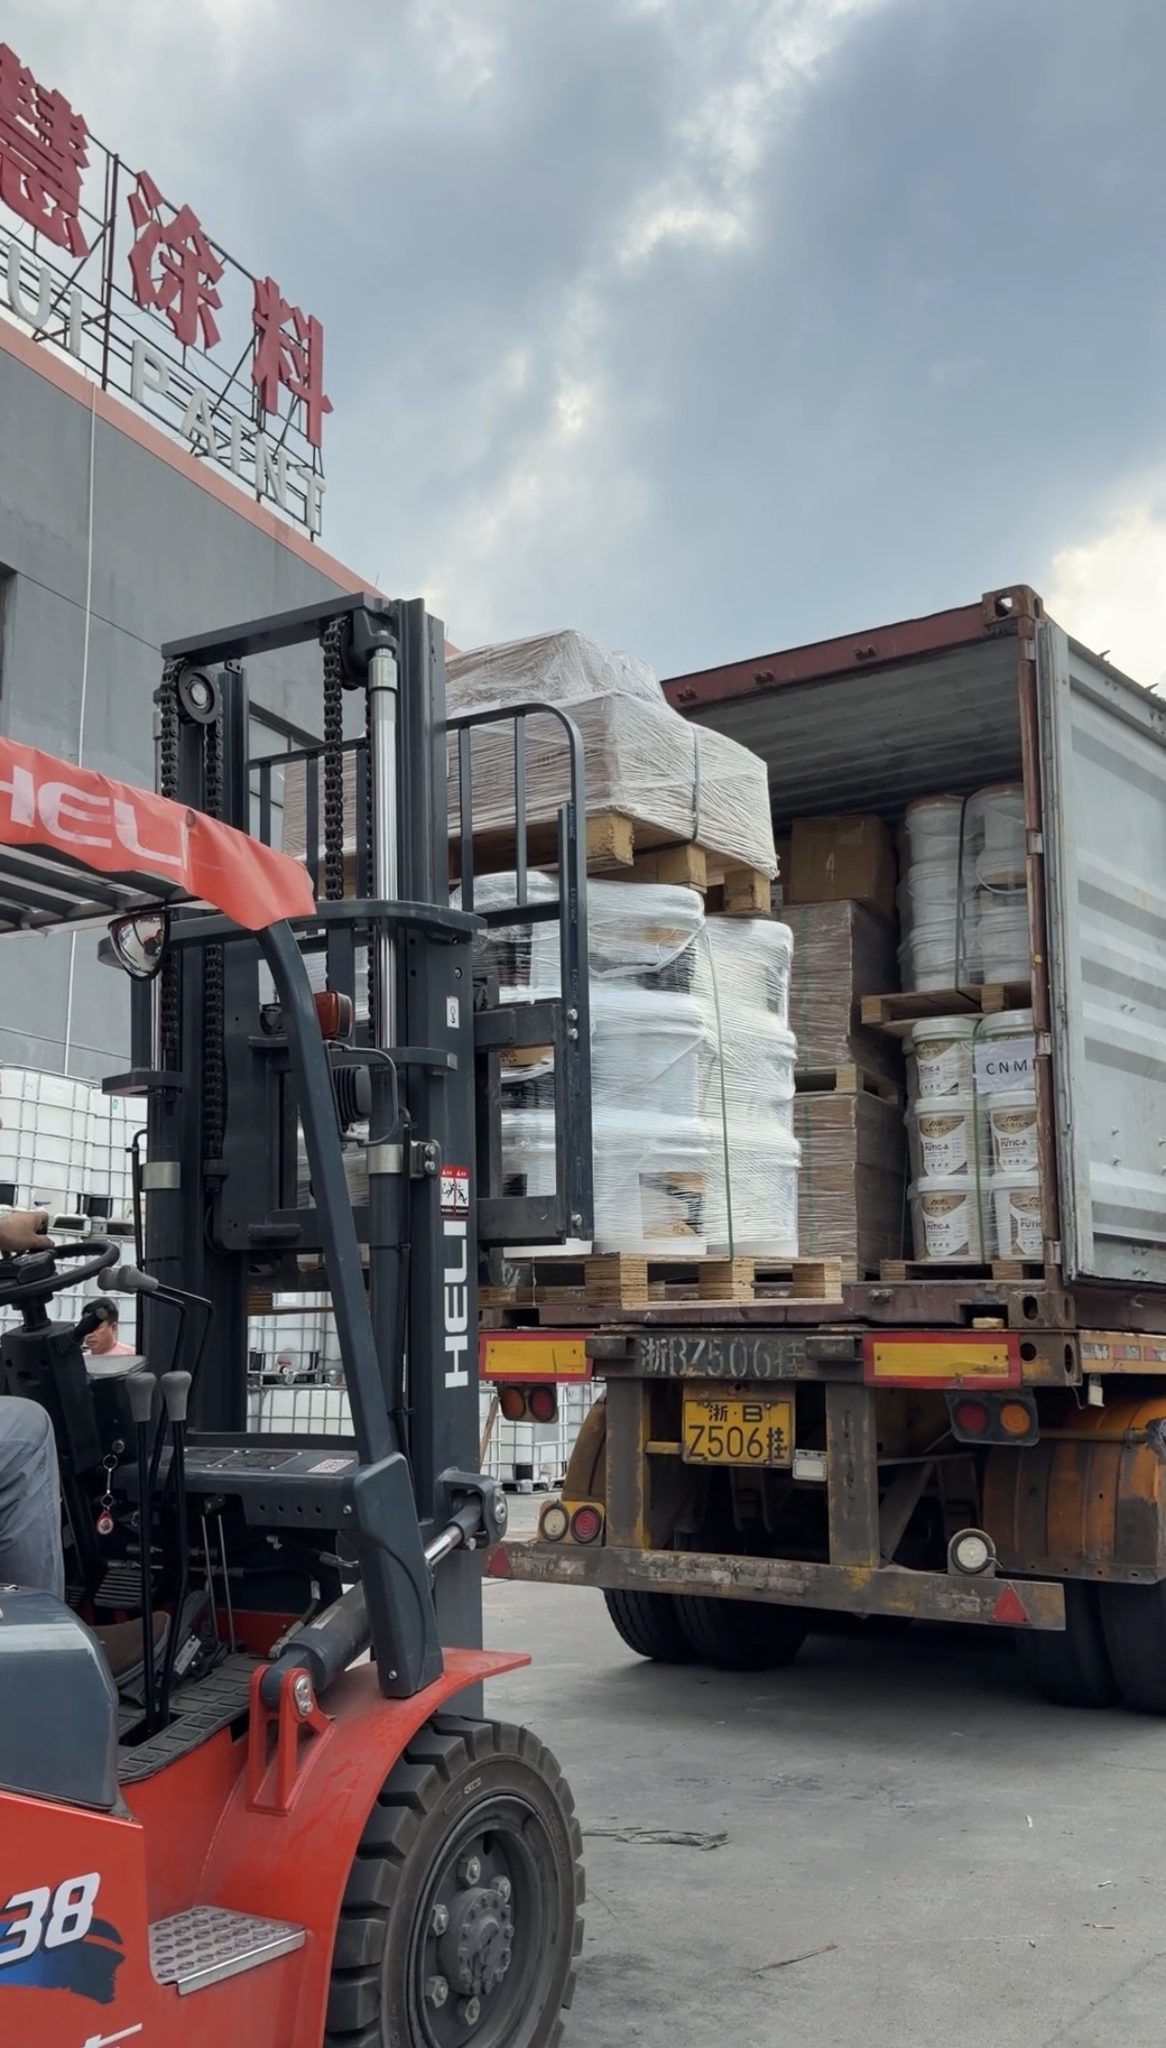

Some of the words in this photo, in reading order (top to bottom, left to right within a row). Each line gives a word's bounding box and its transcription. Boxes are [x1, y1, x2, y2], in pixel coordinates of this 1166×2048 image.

[131, 338, 326, 531] PAINT
[443, 1220, 469, 1388] HELI
[0, 1872, 101, 1965] 38
